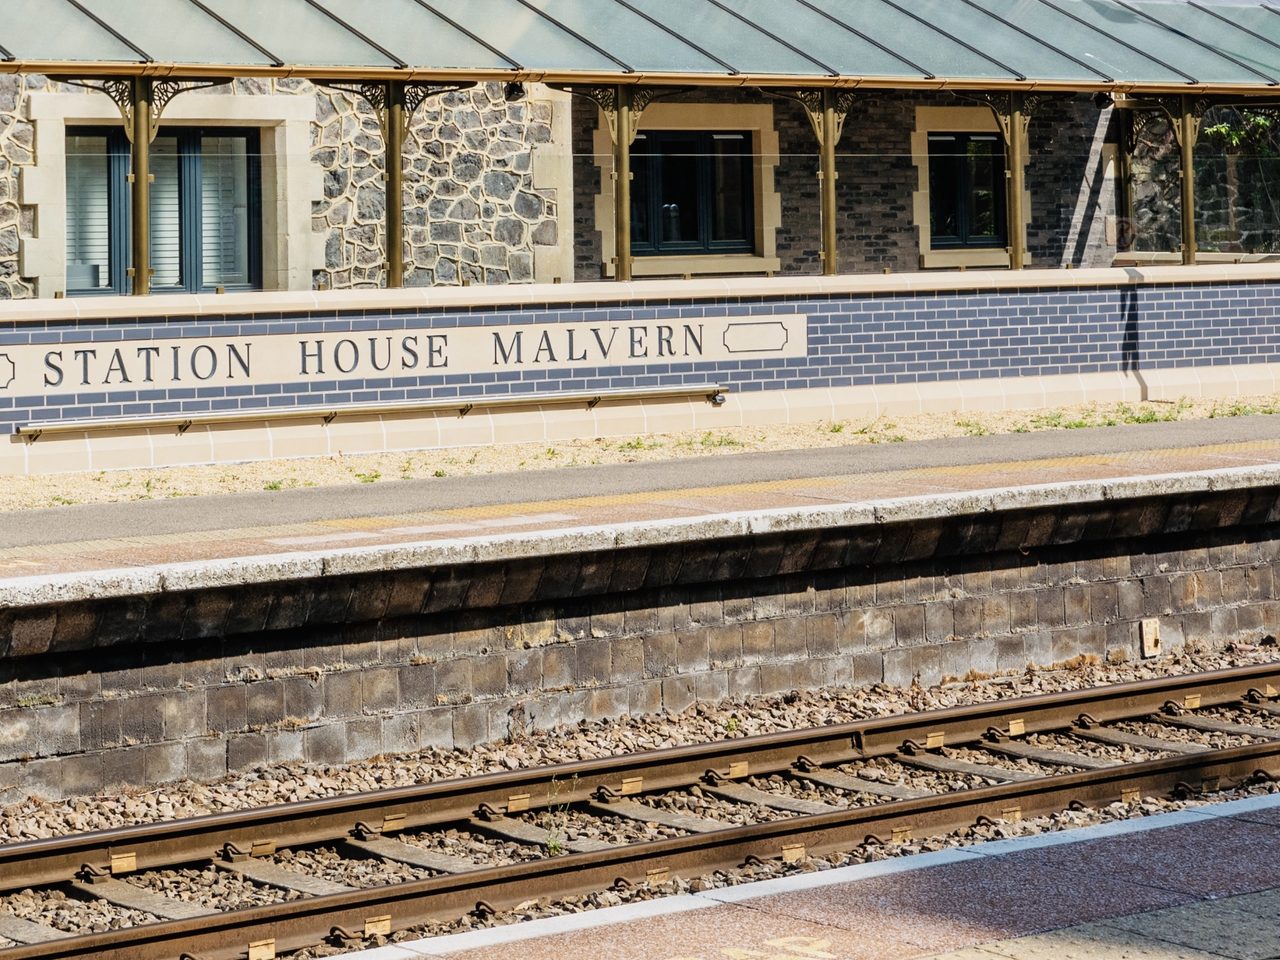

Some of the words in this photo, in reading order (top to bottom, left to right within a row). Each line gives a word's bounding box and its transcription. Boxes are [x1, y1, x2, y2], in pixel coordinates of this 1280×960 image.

[44, 343, 252, 388] STATION
[299, 333, 449, 375] HOUSE
[492, 324, 705, 365] MALVERN
